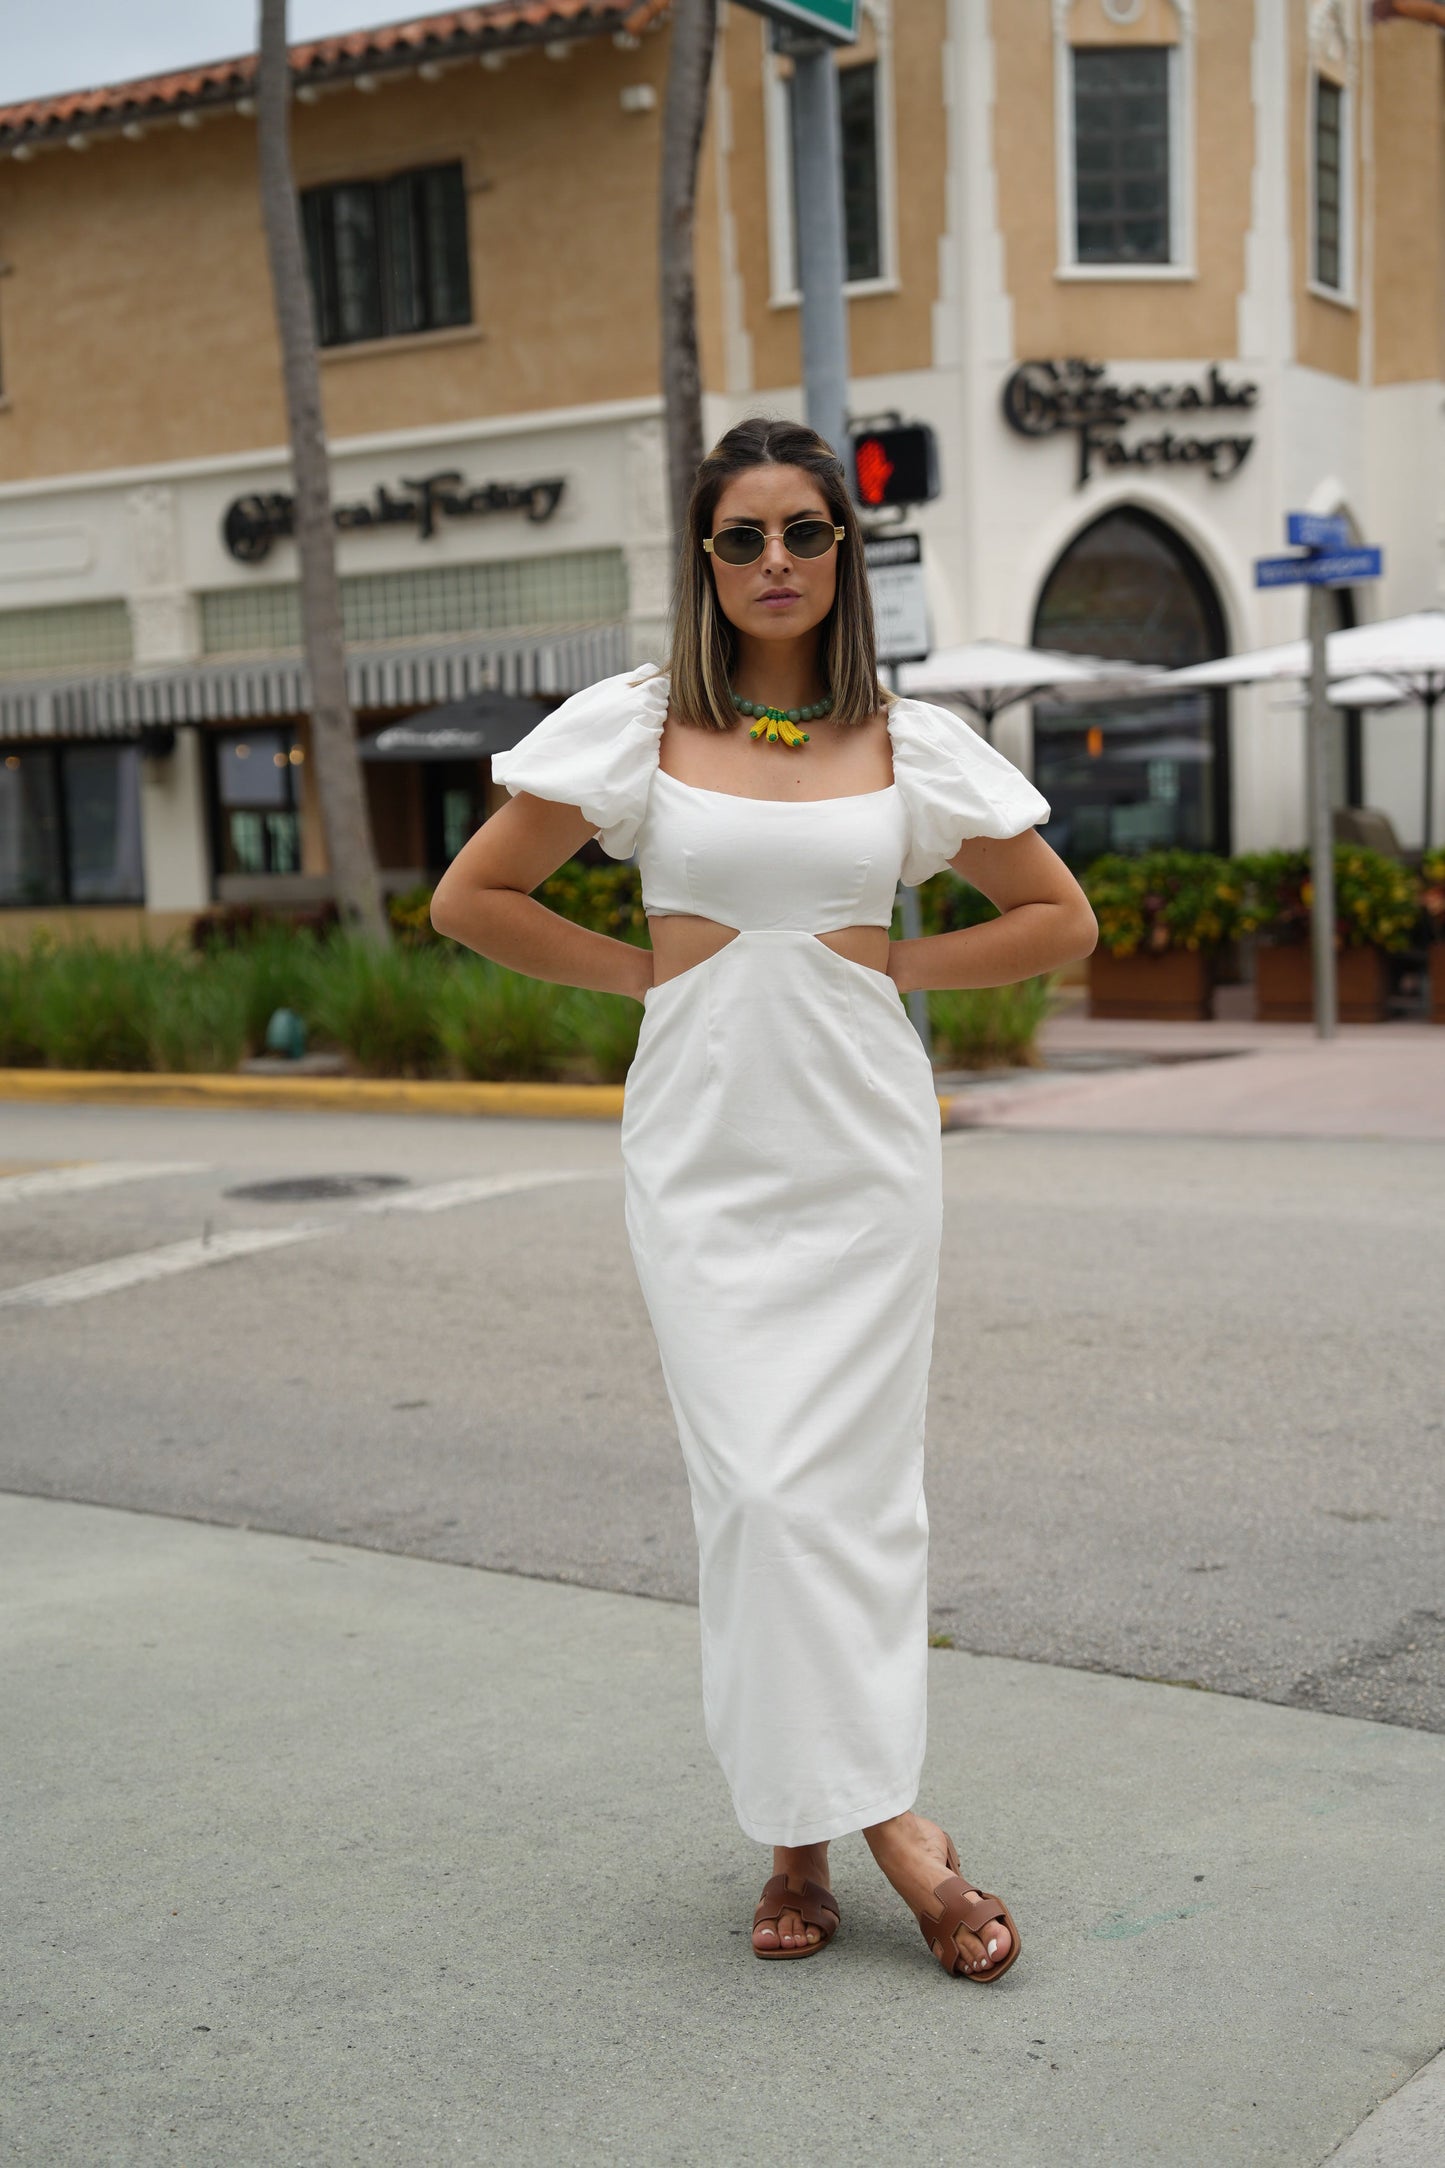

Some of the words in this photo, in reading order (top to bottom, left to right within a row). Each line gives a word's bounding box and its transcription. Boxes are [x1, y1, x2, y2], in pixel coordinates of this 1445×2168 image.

[1003, 361, 1257, 437] Cheesecake
[1057, 413, 1254, 490] Factory
[402, 471, 565, 540] Factory
